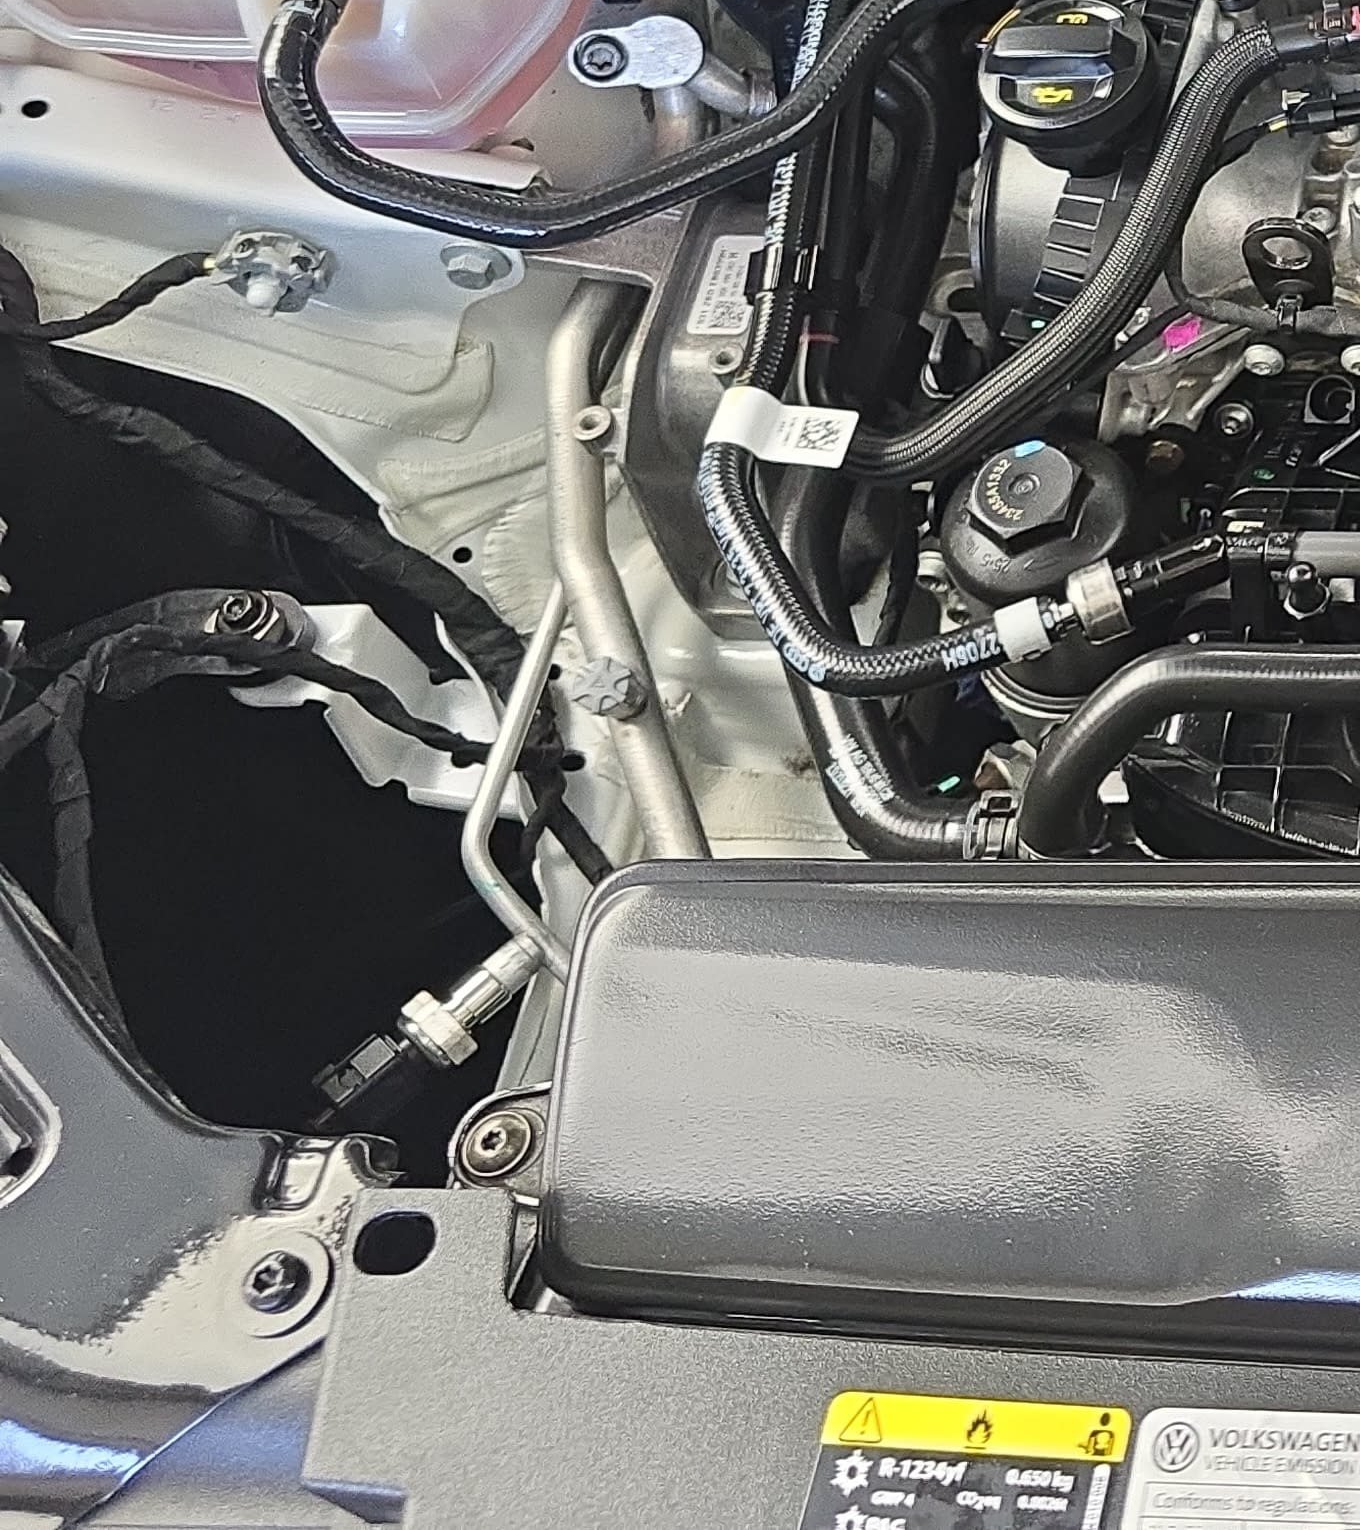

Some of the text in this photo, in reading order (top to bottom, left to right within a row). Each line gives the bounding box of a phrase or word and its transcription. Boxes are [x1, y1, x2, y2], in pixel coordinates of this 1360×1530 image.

[941, 632, 1001, 672] 2706H
[878, 1456, 968, 1486] R-1234yf
[1203, 1455, 1272, 1473] VEHICLE
[1274, 1457, 1357, 1475] EMISSION
[1153, 1491, 1234, 1511] Conforms
[1236, 1494, 1256, 1512] to
